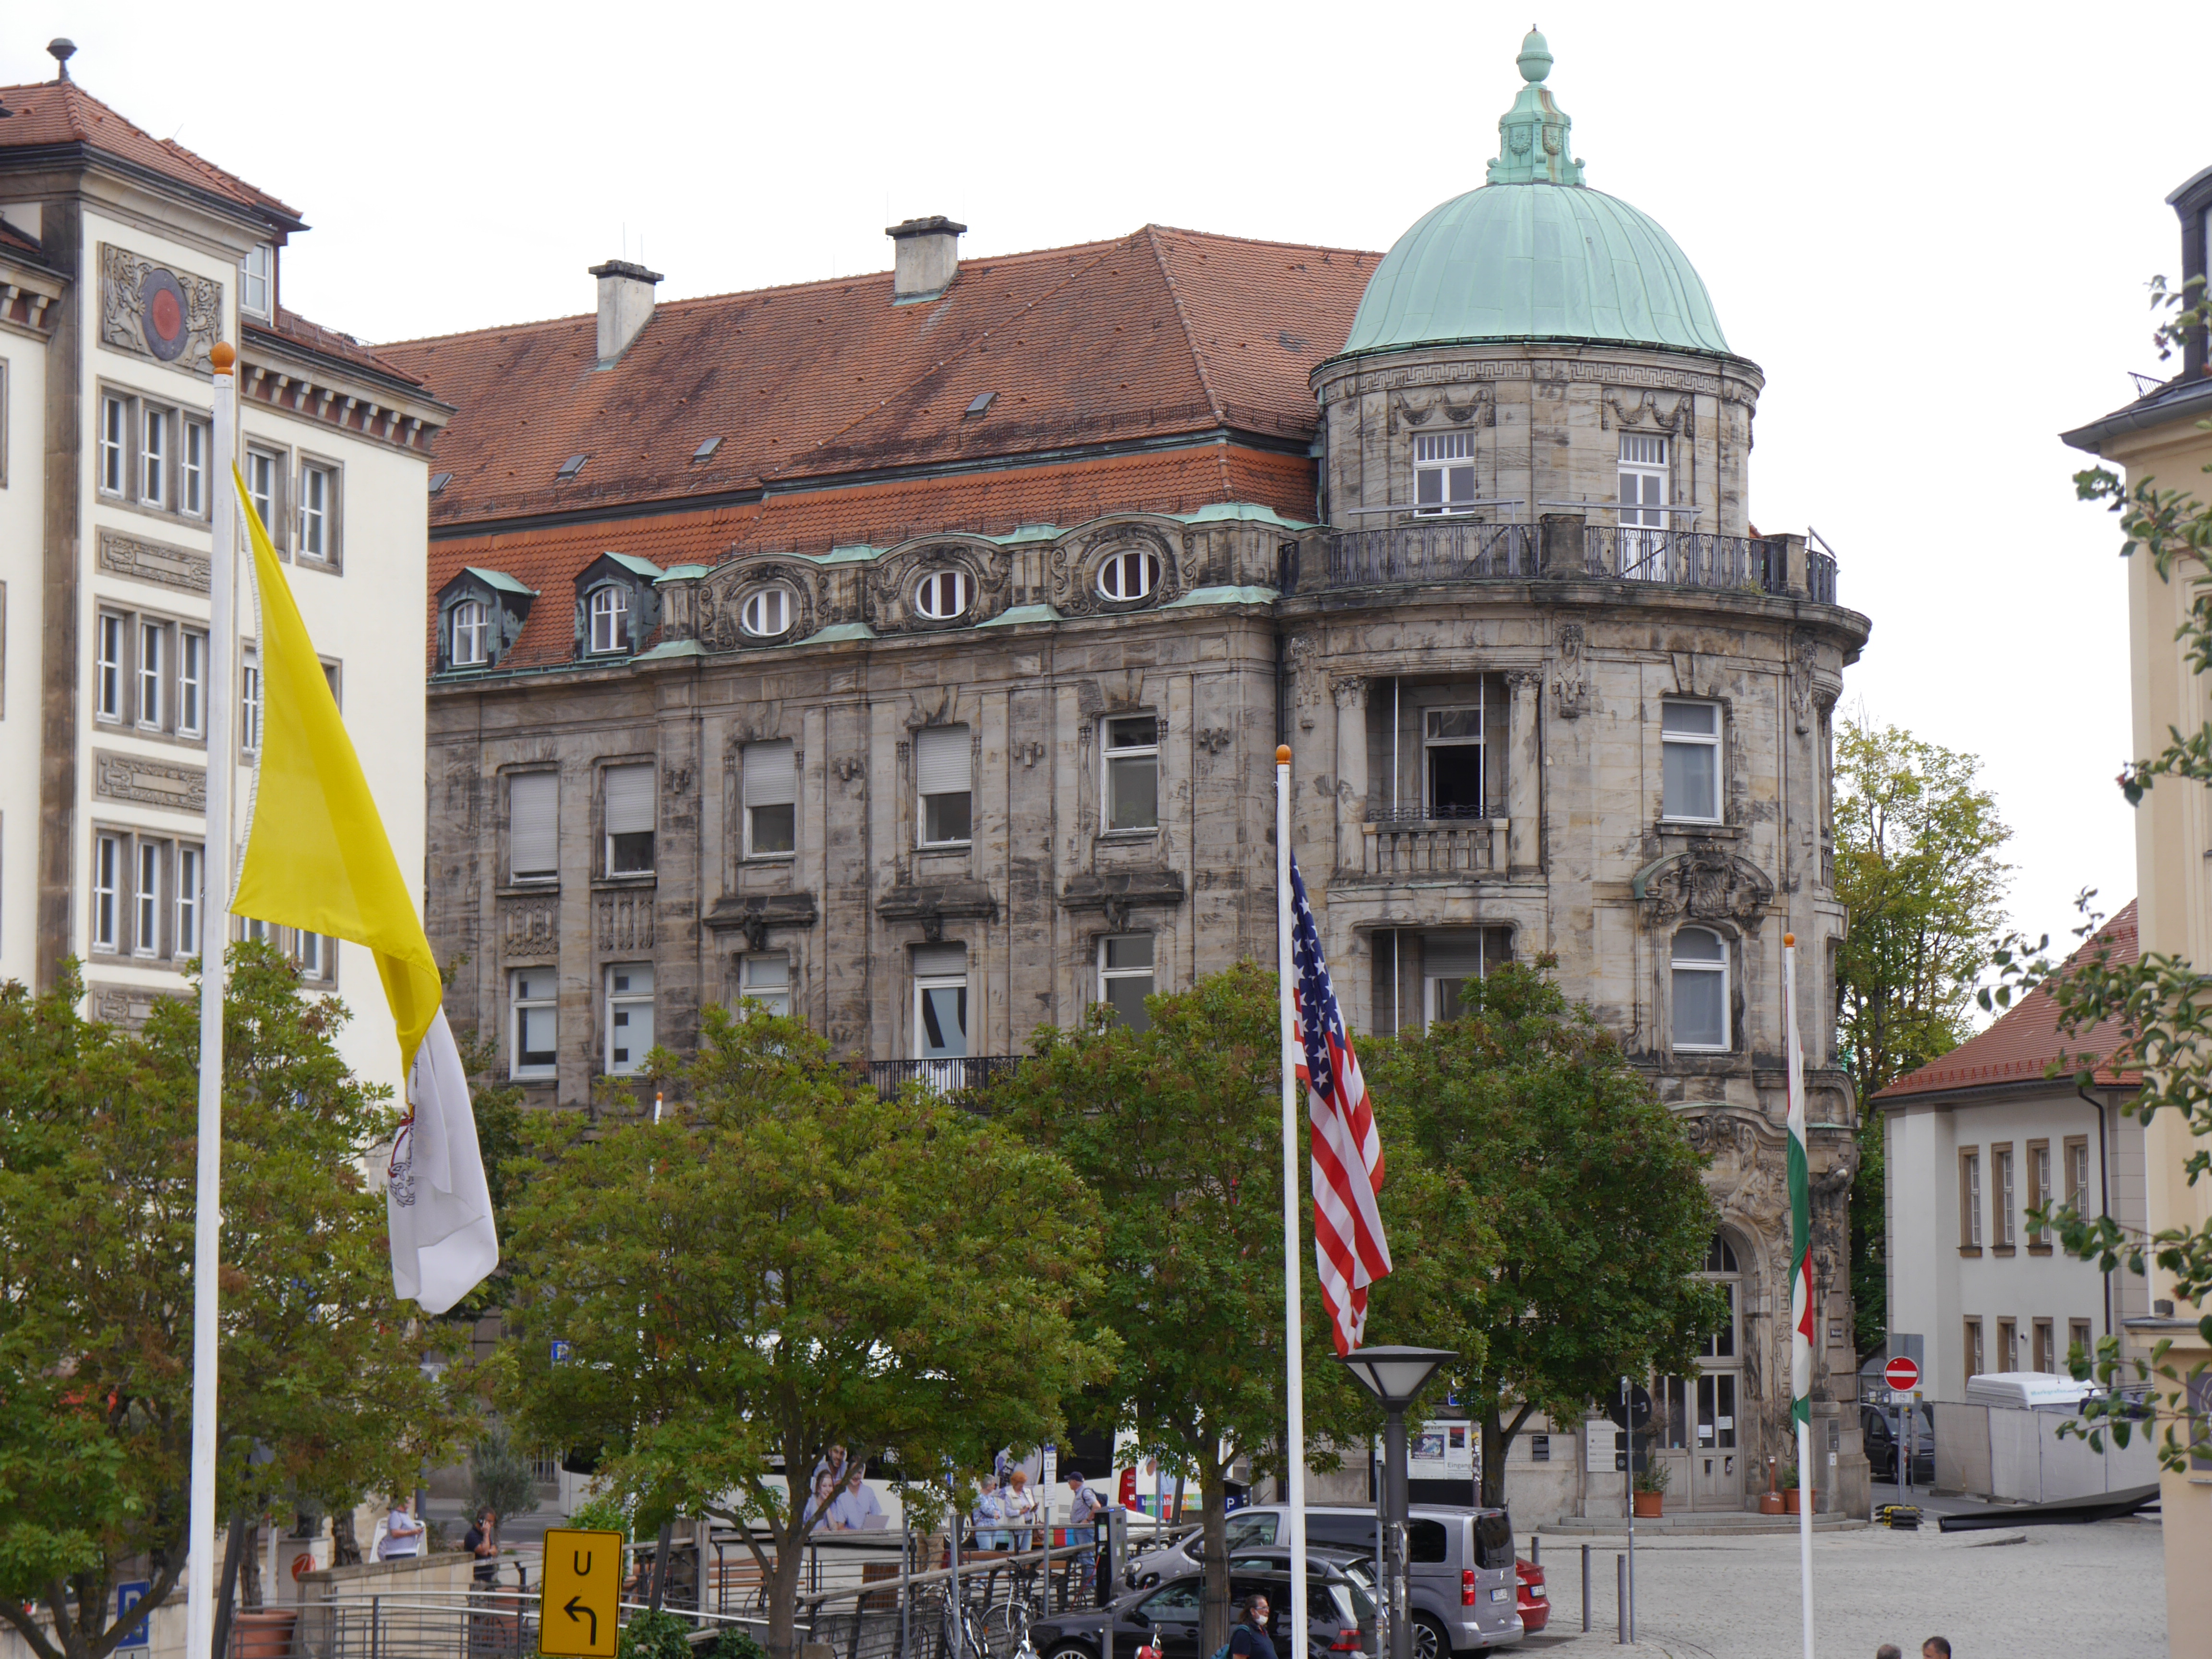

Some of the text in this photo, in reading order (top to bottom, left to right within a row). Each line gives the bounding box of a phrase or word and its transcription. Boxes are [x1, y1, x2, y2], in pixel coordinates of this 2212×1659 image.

[1447, 1462, 1472, 1470] Eingang
[1226, 1498, 1235, 1509] P
[574, 1550, 591, 1576] U
